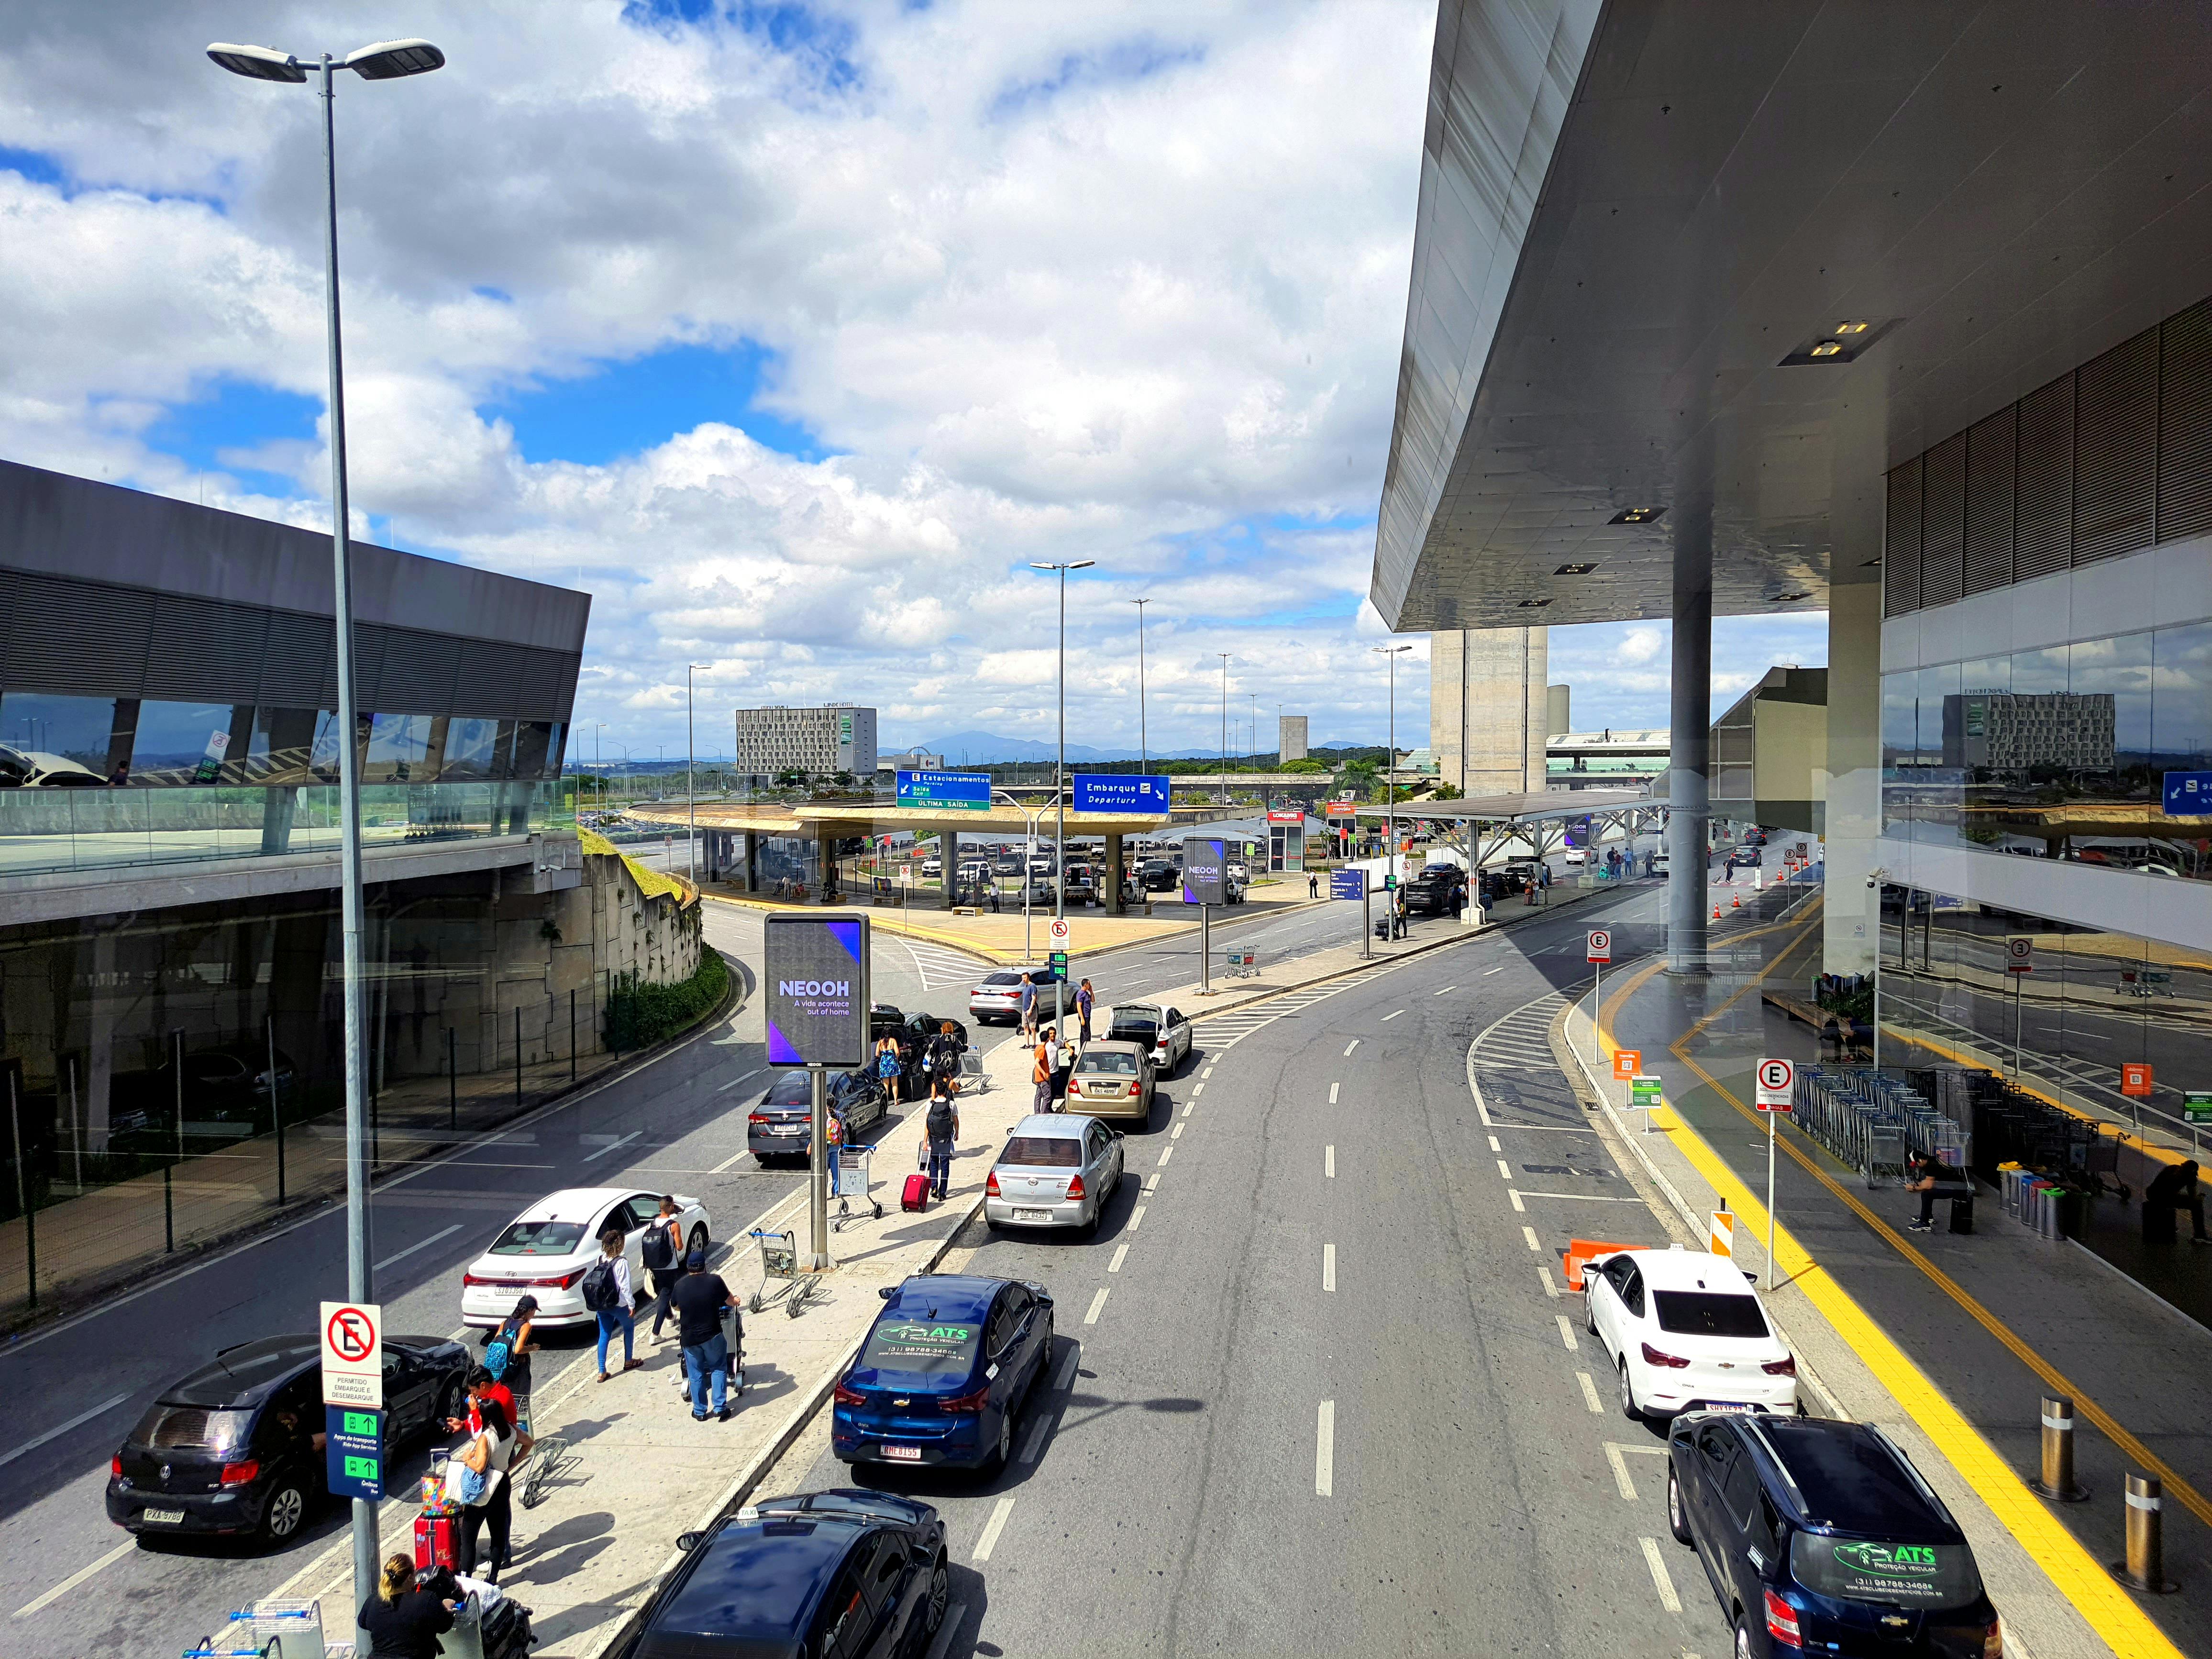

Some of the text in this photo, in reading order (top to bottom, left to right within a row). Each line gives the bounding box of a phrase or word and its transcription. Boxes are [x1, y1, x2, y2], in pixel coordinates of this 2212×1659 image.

[923, 774, 989, 783] Estacionamentos
[1087, 784, 1136, 794] Embarque
[1088, 796, 1136, 804] Departure
[1188, 866, 1218, 874] NEOOH
[1056, 924, 1062, 934] E
[1596, 936, 1602, 945] E
[779, 980, 849, 996] NEOOH
[1770, 1066, 1781, 1083] E
[343, 1318, 361, 1352] E
[929, 1327, 968, 1339] ATS
[332, 1392, 374, 1401] DESEMBARQUE
[1894, 1546, 1936, 1563] ATS
[1874, 1580, 1927, 1589] 98788-3468
